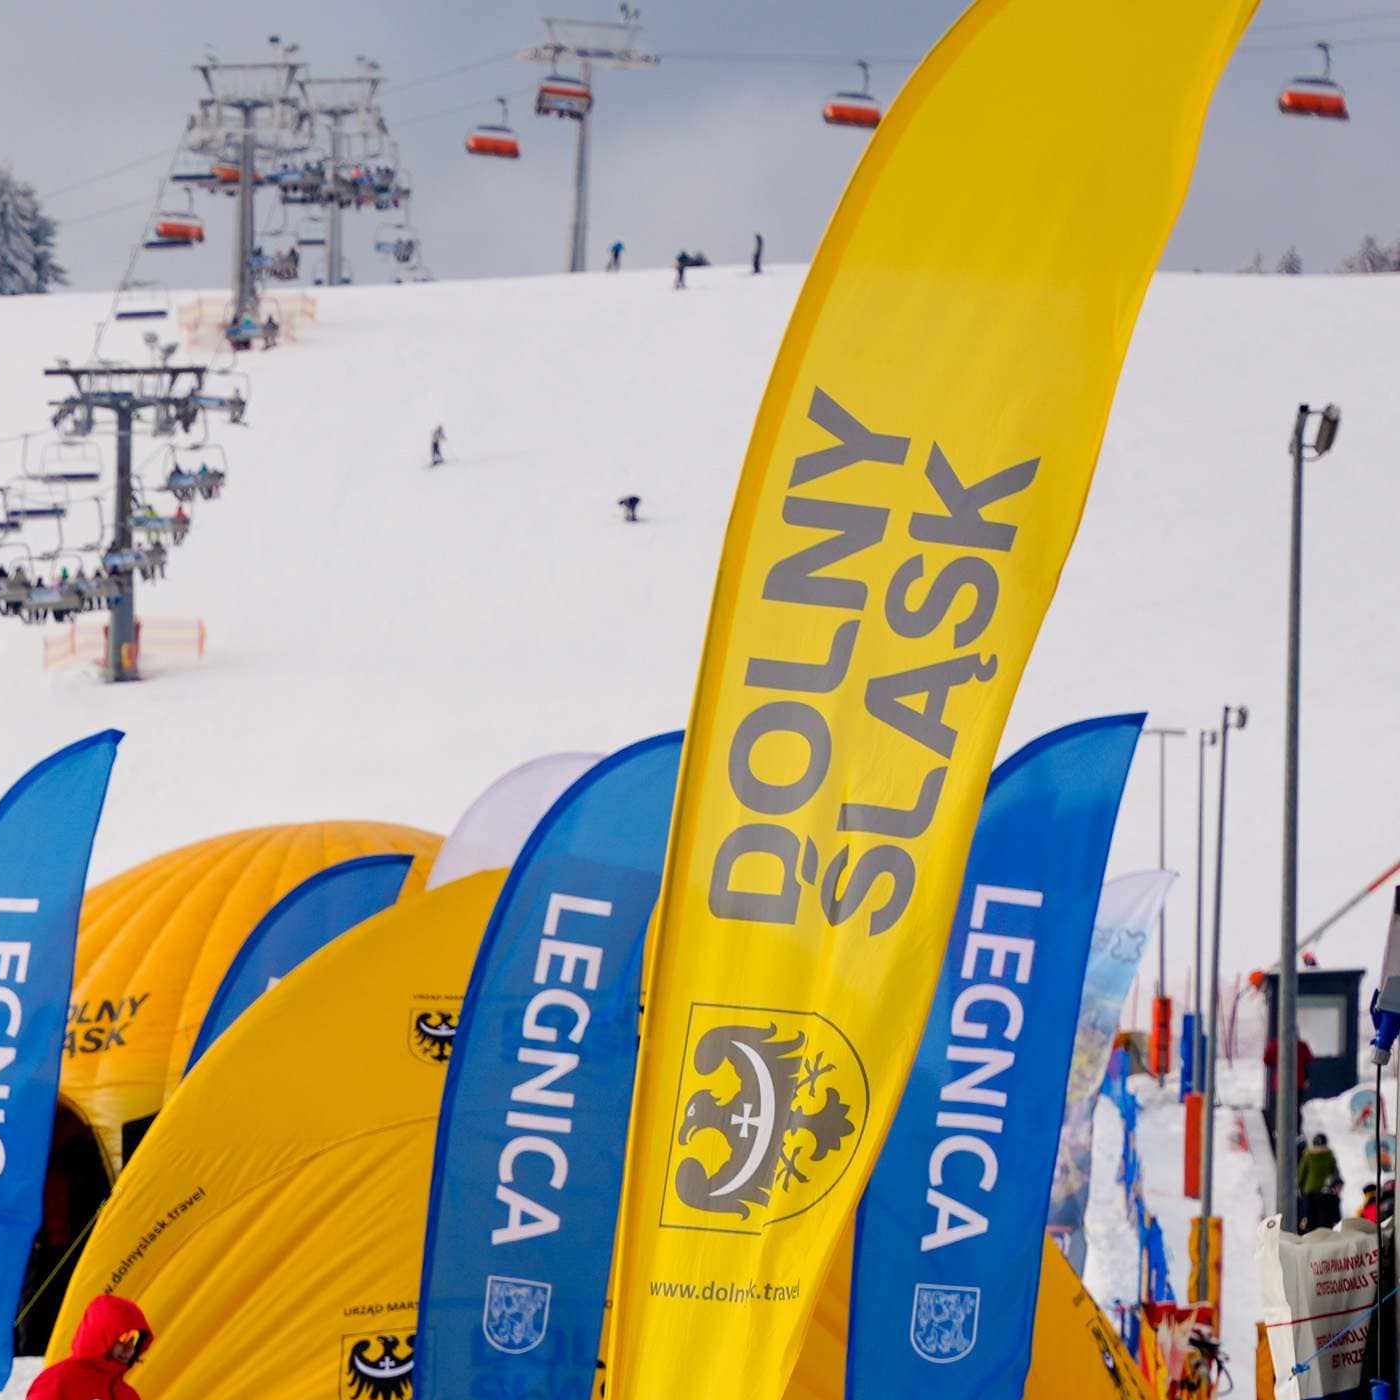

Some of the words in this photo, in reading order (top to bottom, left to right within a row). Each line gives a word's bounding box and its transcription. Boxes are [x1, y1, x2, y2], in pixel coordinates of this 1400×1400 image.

[708, 386, 911, 925] DOLNY
[798, 440, 1041, 936] ŚLĄSK
[492, 893, 612, 1245] LEGNICA
[921, 884, 1043, 1252] LEGNICA
